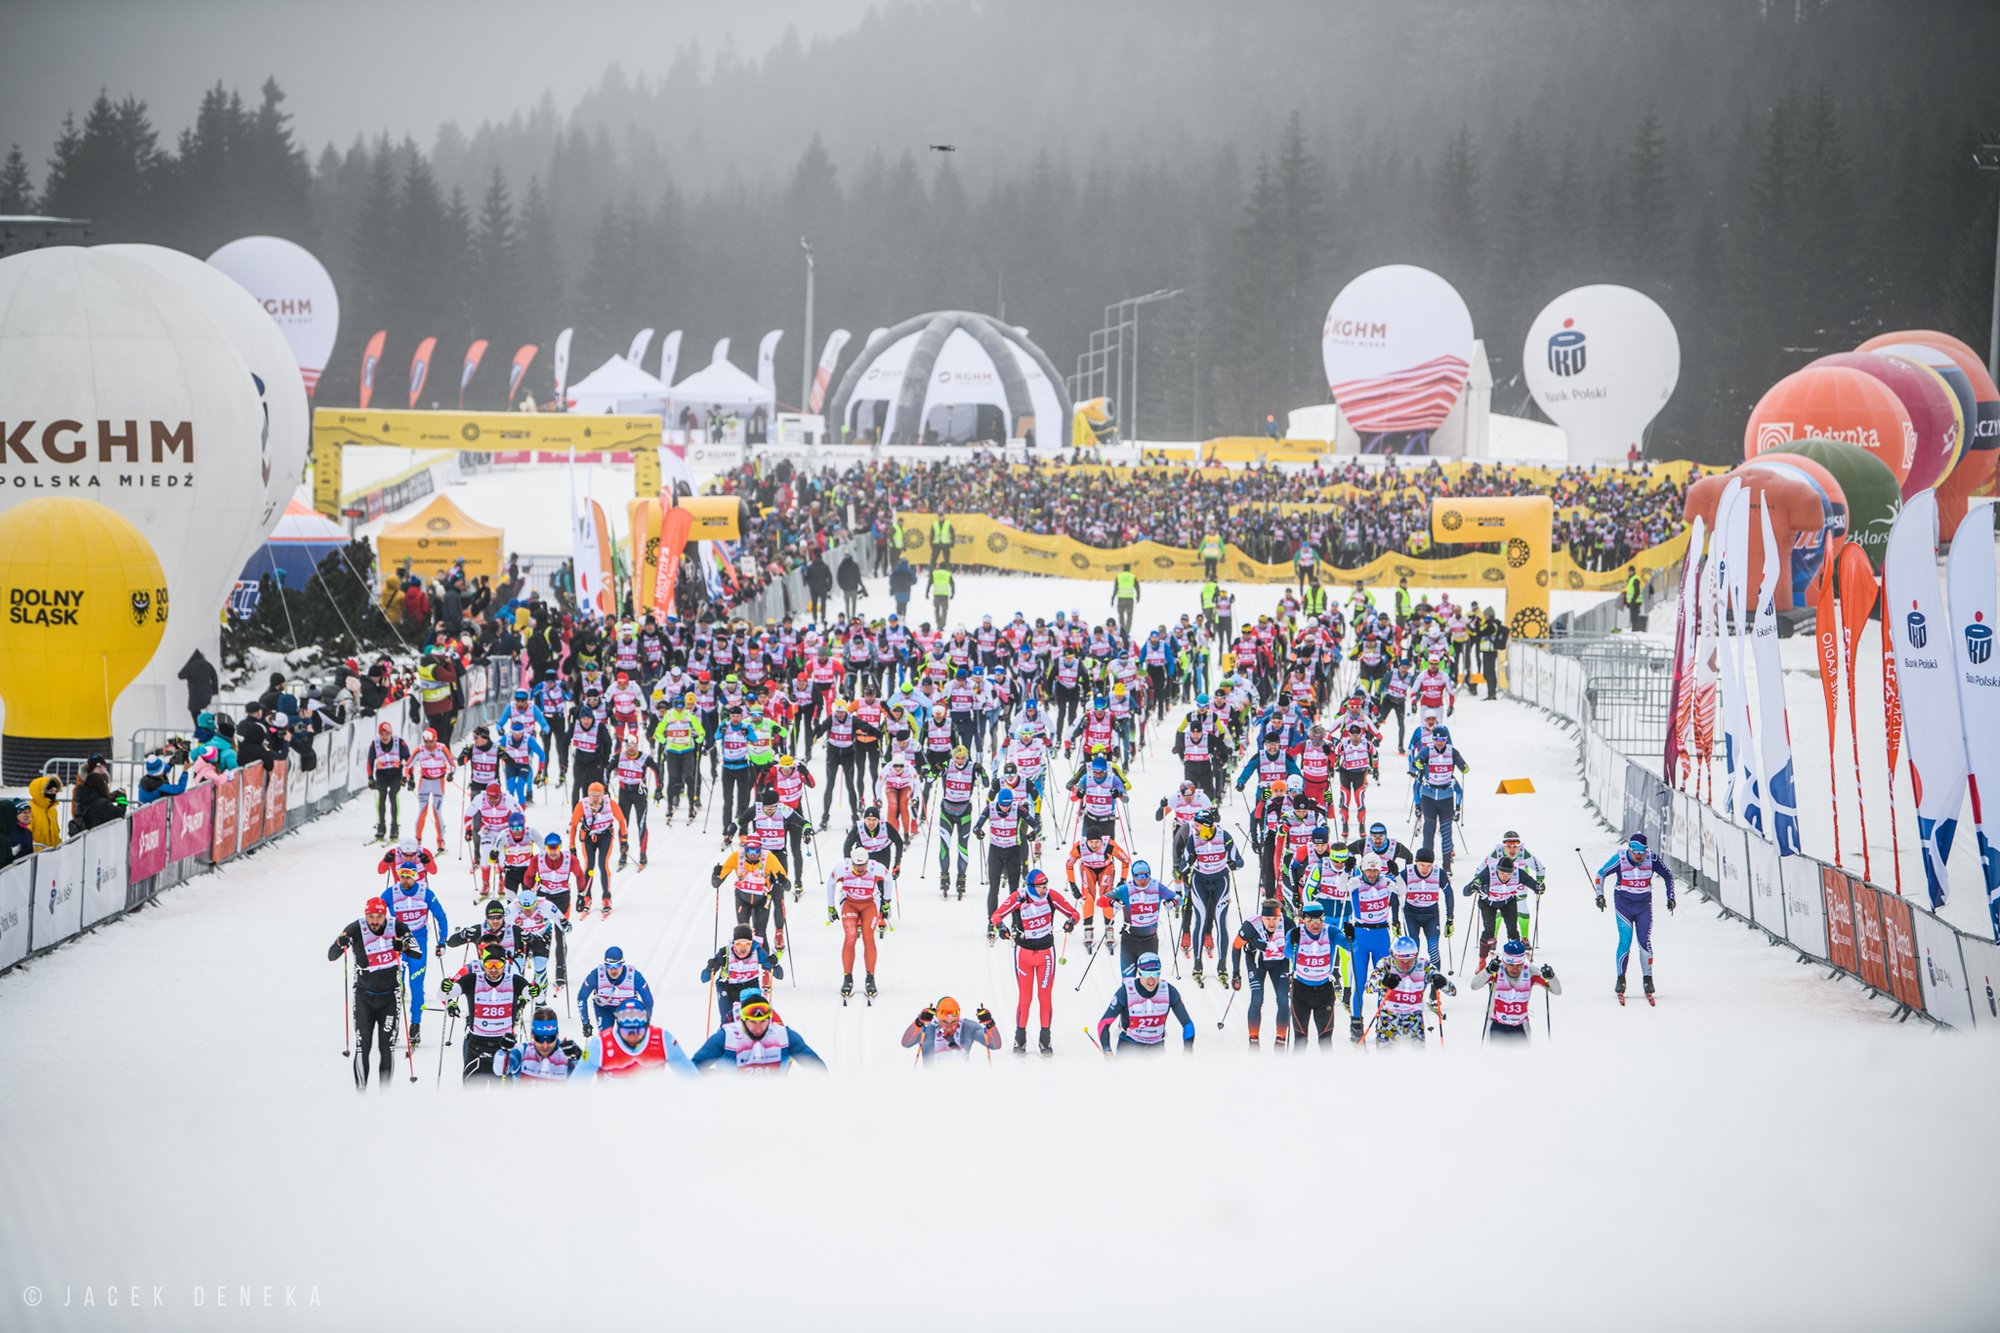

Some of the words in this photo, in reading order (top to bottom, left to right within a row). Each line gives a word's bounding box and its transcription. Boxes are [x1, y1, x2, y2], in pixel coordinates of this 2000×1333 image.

[263, 299, 312, 315] GHM
[1332, 320, 1386, 338] KGHM
[0, 420, 194, 464] KGHM
[0, 475, 101, 488] POLSKA
[120, 473, 193, 487] MIEDŹ
[10, 589, 84, 606] DOLNY
[10, 605, 78, 627] ŚLĄSK
[1905, 658, 1918, 668] Bank
[1919, 658, 1937, 669] Polski
[951, 782, 966, 790] 216
[1092, 796, 1107, 804] 143
[995, 828, 1011, 836] 342
[1203, 854, 1220, 862] 302
[1414, 893, 1432, 901] 220
[1367, 901, 1385, 910] 263
[402, 912, 421, 921] 588
[1028, 918, 1047, 928] 236
[1305, 956, 1325, 966] 185
[1395, 993, 1417, 1003] 158
[482, 1007, 505, 1016] 286
